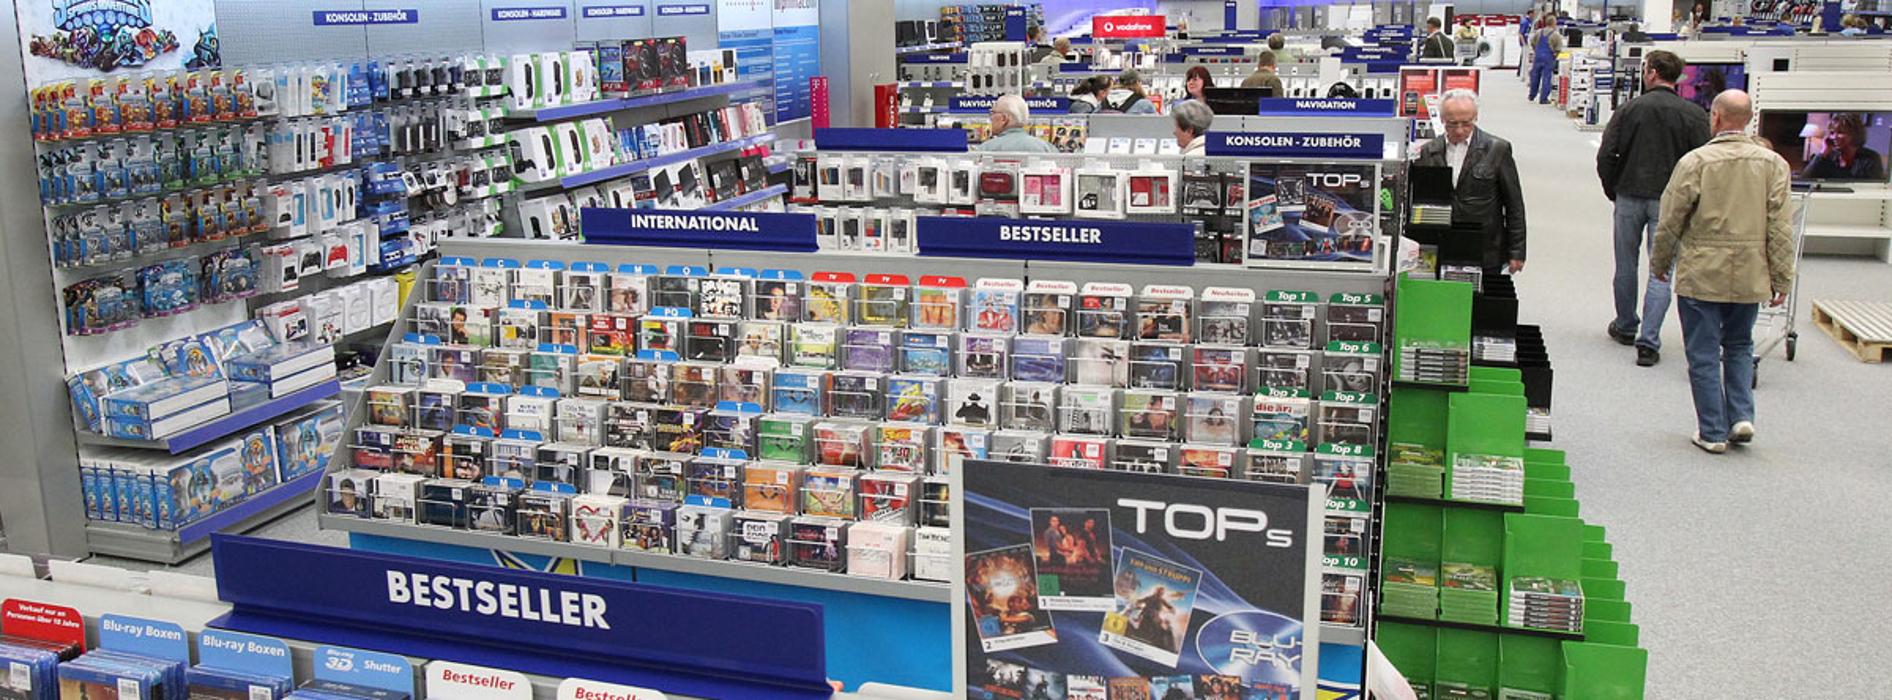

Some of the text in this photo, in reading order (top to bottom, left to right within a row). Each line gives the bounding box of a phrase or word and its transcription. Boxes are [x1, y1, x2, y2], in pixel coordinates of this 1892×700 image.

[325, 12, 369, 23] KONSOLEN
[374, 9, 408, 22] ZUBEHÖR
[1115, 22, 1152, 31] vodafone
[1296, 100, 1356, 109] NAVIGATION
[1225, 136, 1294, 147] KONSOLEN
[1302, 134, 1361, 148] ZUBEHÖR
[631, 214, 759, 232] INTERNATIONAL
[1000, 226, 1102, 245] BESTSELLER
[586, 262, 594, 271] H
[634, 265, 642, 274] M
[983, 280, 1017, 288] Bestseller
[1035, 282, 1070, 290] Bestseller
[1090, 285, 1126, 293] Bestseller
[1151, 287, 1186, 296] Bestseller
[1211, 289, 1250, 298] Neuheiten
[1277, 290, 1306, 301] Top 1
[1341, 293, 1372, 304] Top 5
[1339, 342, 1370, 353] Top 6
[1268, 387, 1299, 398] Top 2
[1334, 392, 1366, 404] Top 7
[1262, 440, 1293, 451] Top 3
[1331, 443, 1362, 455] Top 8
[702, 497, 713, 505] W
[1348, 501, 1357, 509] 9
[1323, 556, 1359, 567] op 10
[386, 569, 611, 630] BESTSELLER
[1041, 598, 1047, 607] 1
[18, 603, 43, 614] Verkauf
[44, 608, 56, 616] nur
[6, 610, 36, 621] Personen
[62, 618, 80, 628] Jahre
[103, 619, 182, 641] Blu-ray Boxen
[1102, 632, 1109, 642] 3
[202, 635, 285, 657] Blu-ray Boxen
[985, 641, 992, 650] 2
[1229, 648, 1301, 669] RAY
[324, 656, 402, 674] 3D Shutter
[442, 669, 516, 691] Bestseller
[575, 686, 640, 700] Bestsell
